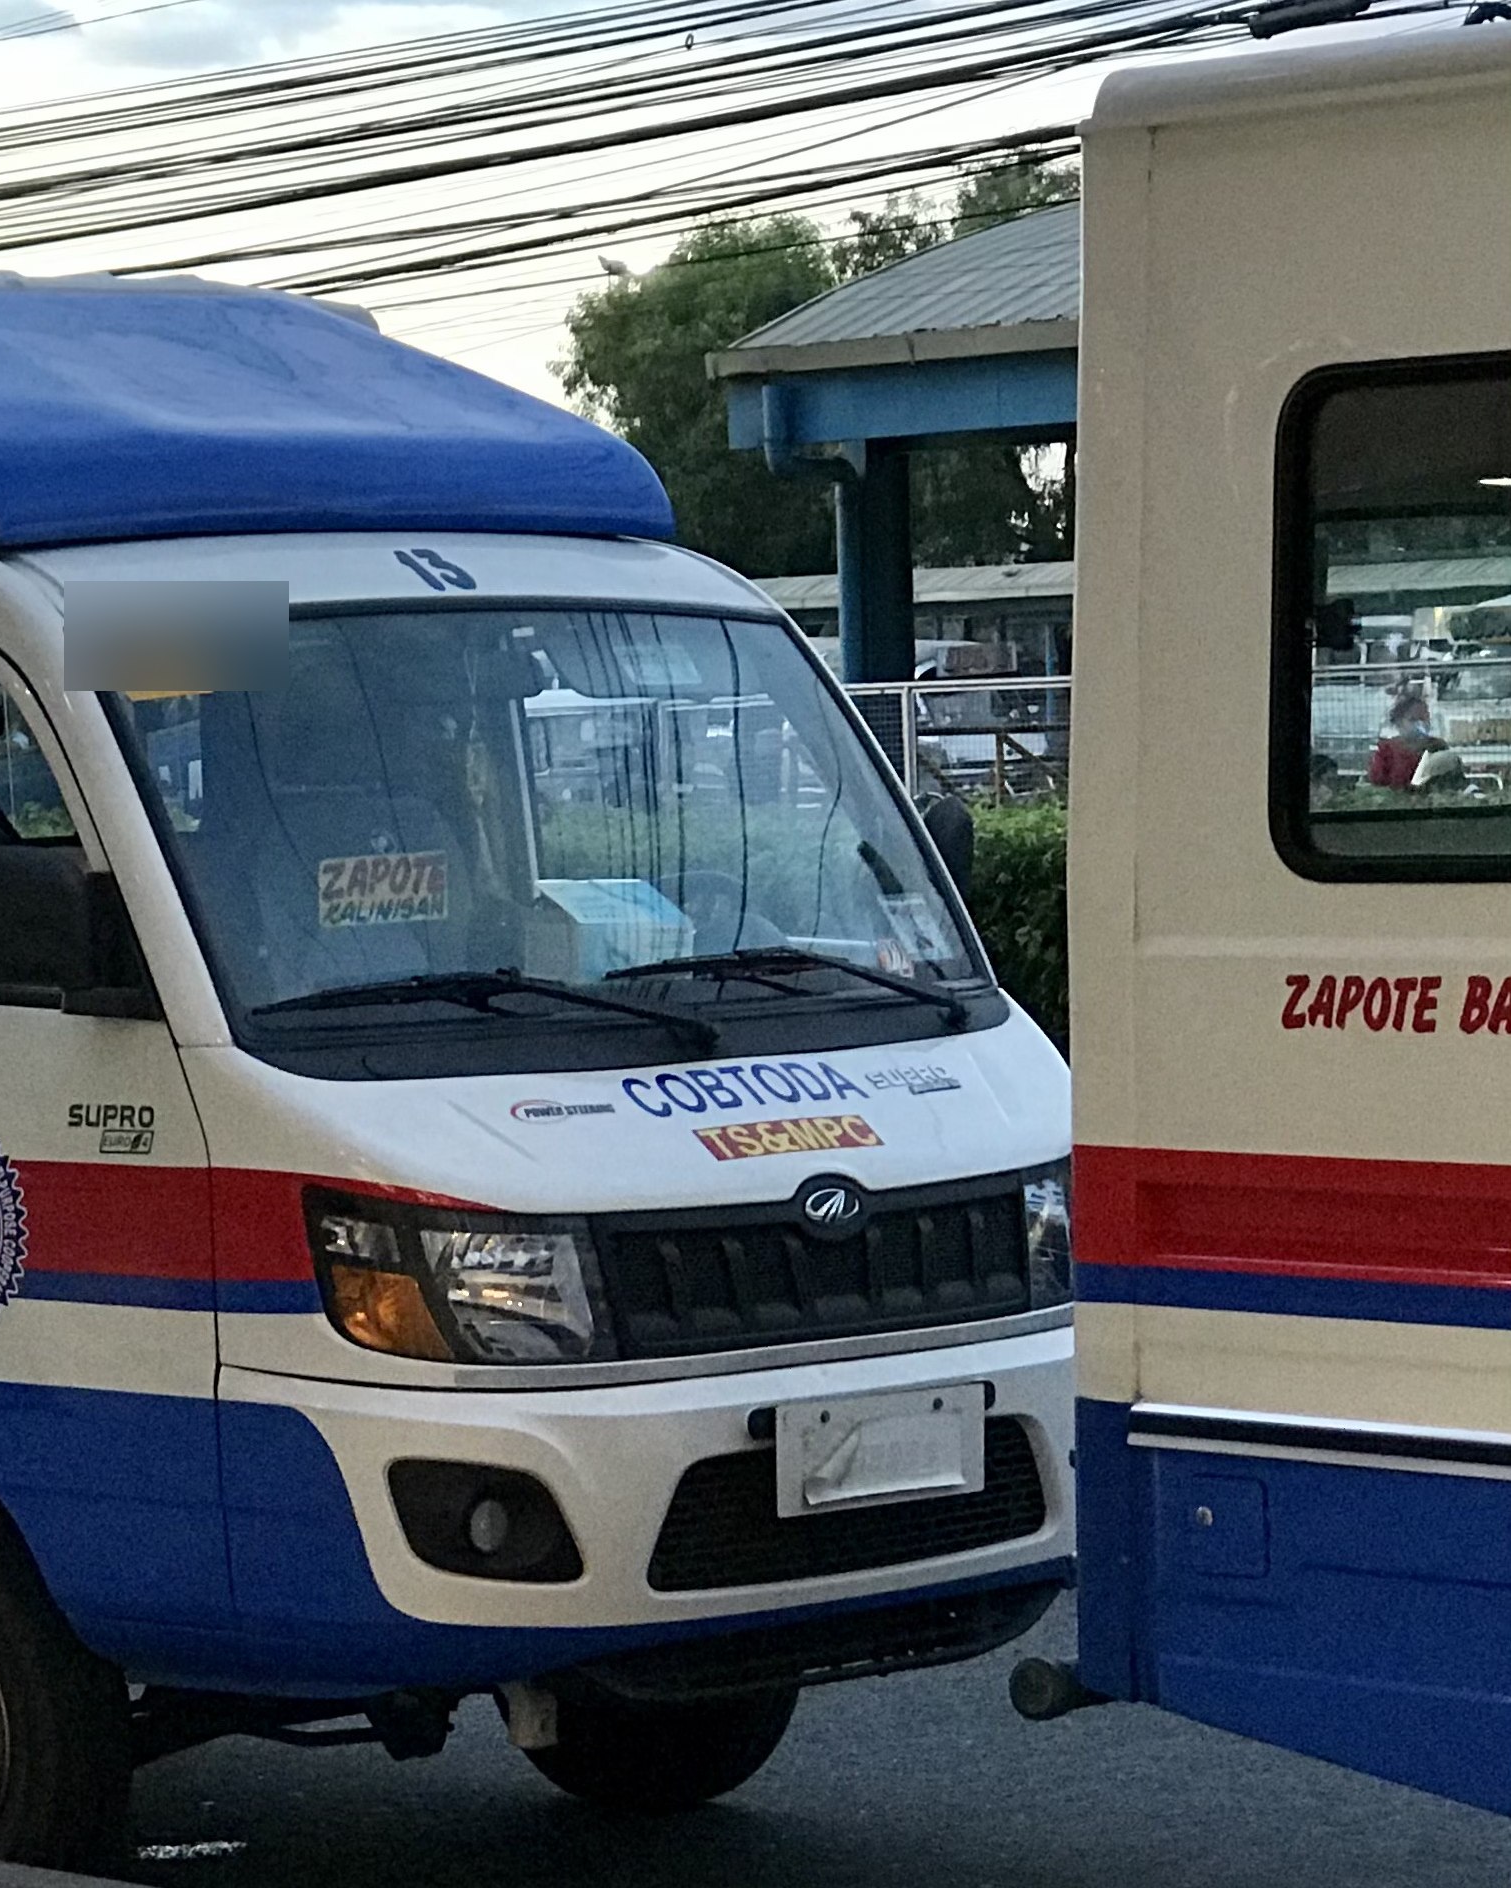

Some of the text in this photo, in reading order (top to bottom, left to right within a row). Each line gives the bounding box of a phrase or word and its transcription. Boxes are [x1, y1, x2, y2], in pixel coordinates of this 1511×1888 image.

[1282, 975, 1442, 1033] ZAPOTE
[622, 1061, 870, 1118] COBTODA
[68, 1104, 154, 1128] SUPRO
[524, 1105, 564, 1119] POWER
[697, 1114, 880, 1158] TS&MPC
